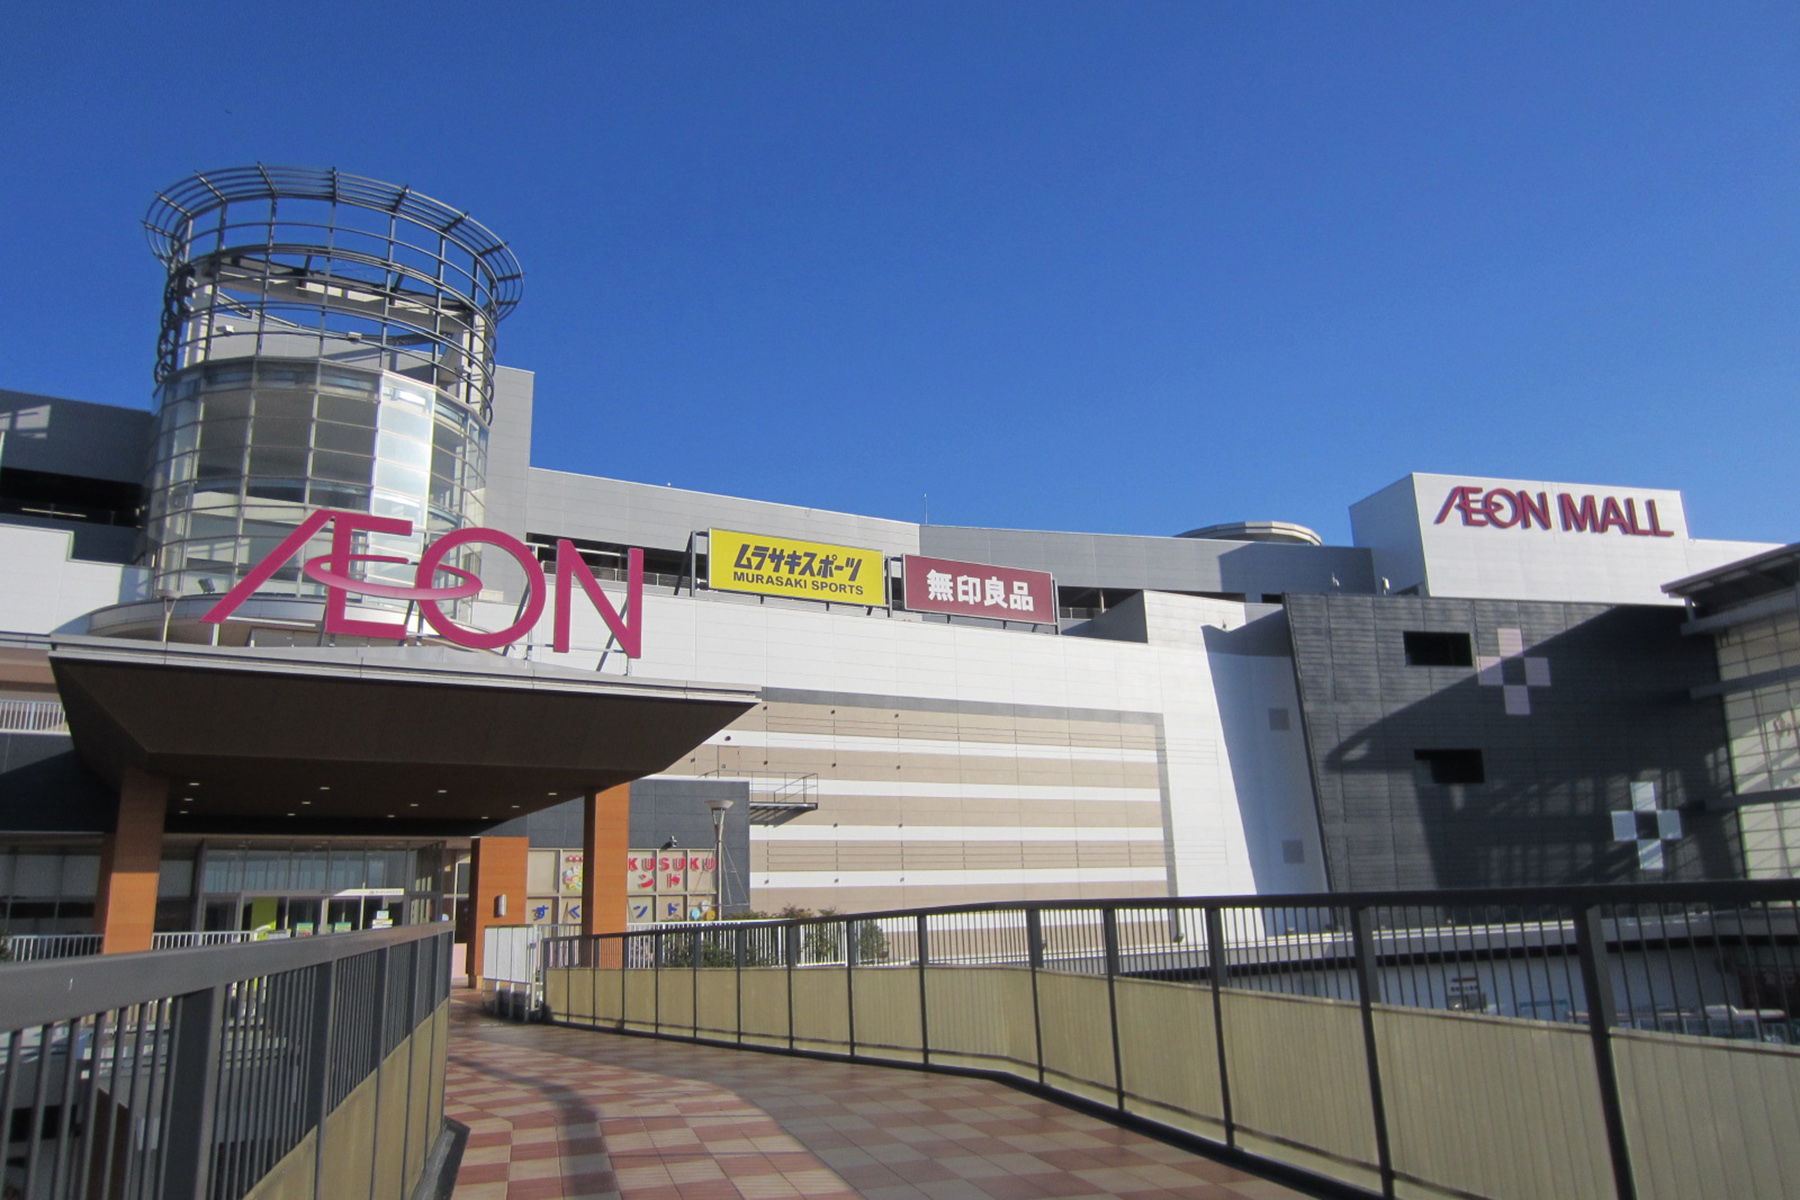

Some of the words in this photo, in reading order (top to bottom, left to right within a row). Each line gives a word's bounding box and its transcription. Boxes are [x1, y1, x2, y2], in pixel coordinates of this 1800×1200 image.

[1557, 493, 1675, 537] MALL
[733, 543, 863, 582] ムラサキスポーツ
[733, 571, 808, 589] MURASAKI
[811, 580, 864, 596] SPORTS
[926, 569, 1035, 612] 無印良品
